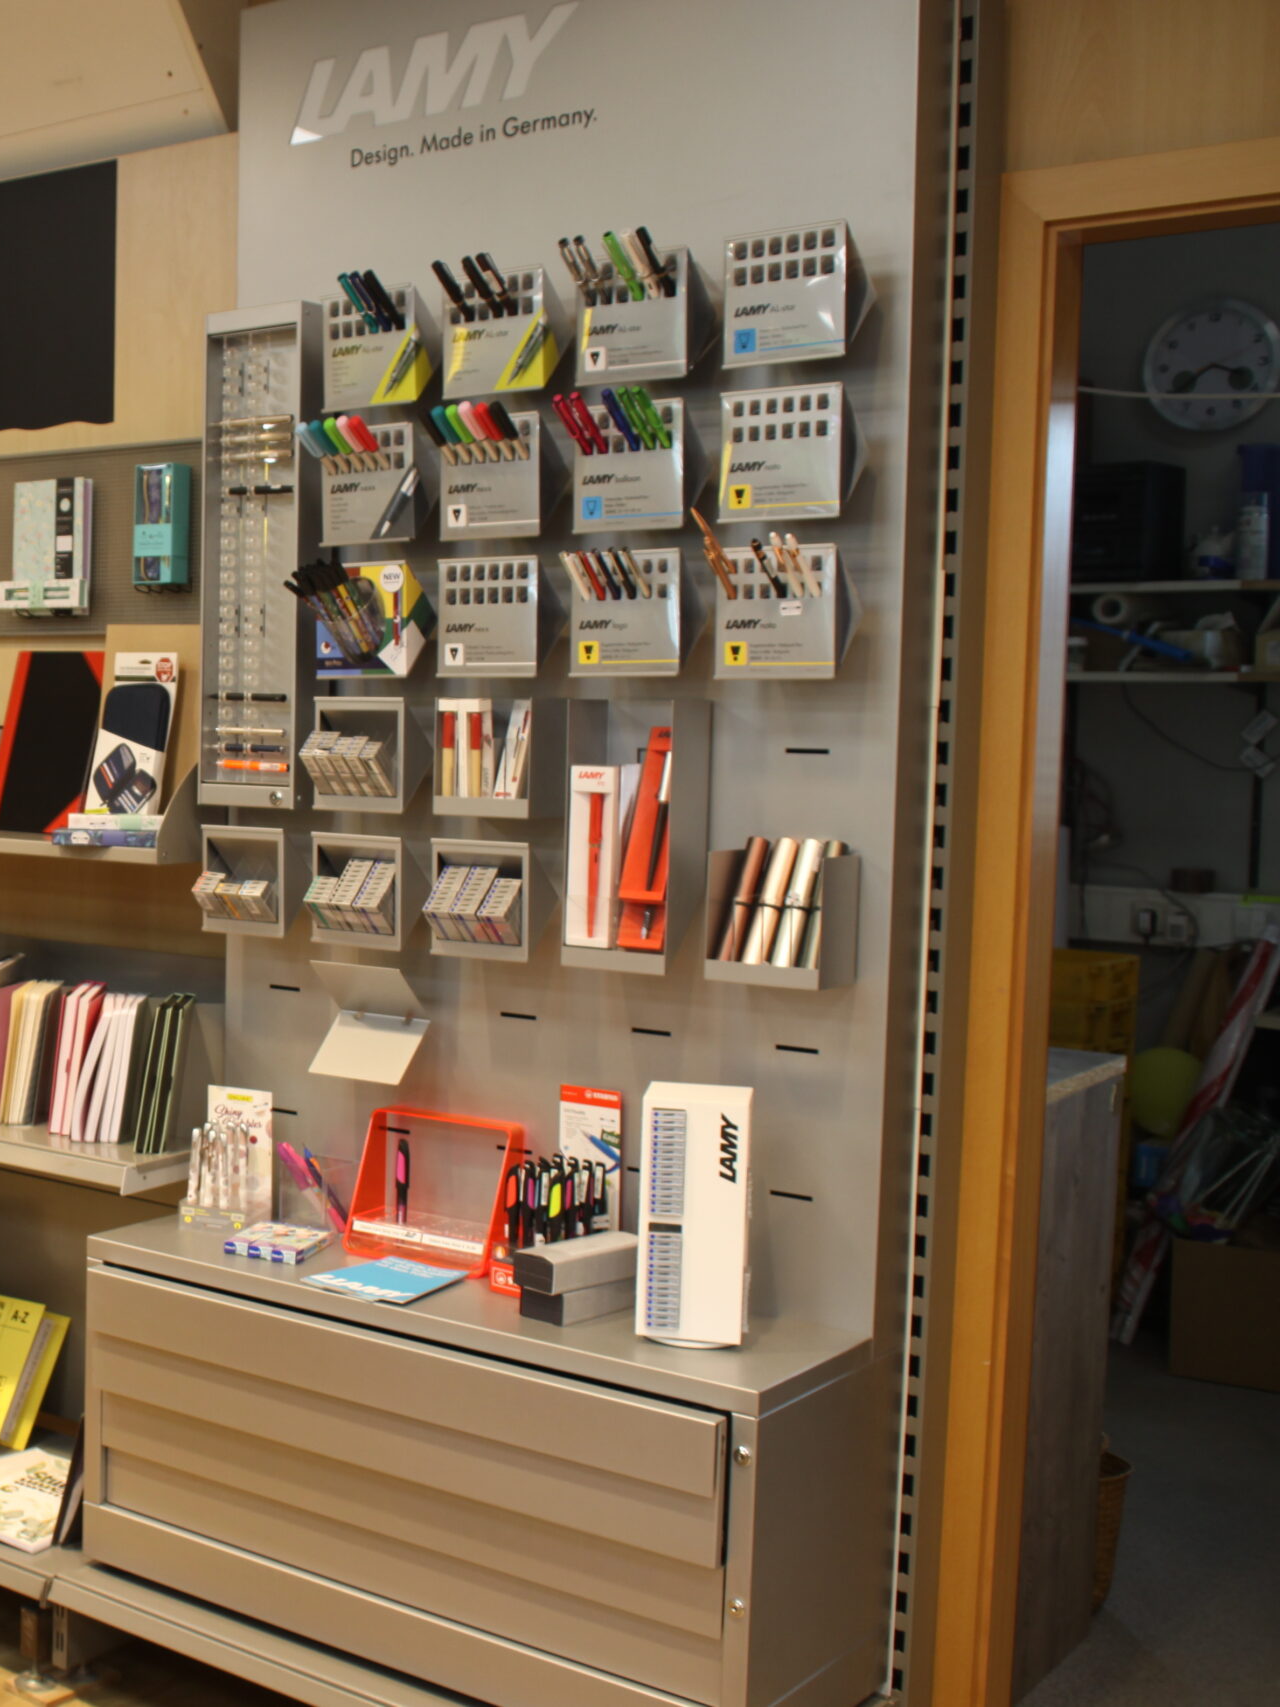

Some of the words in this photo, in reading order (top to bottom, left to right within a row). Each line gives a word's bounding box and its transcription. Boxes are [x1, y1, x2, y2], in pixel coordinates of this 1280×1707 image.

[289, 1, 579, 146] LAMY
[350, 145, 415, 169] Design.
[420, 127, 474, 154] Made
[480, 124, 496, 142] in
[502, 107, 598, 138] Germany.
[734, 303, 770, 318] LAMY
[719, 1113, 738, 1184] LAMY
